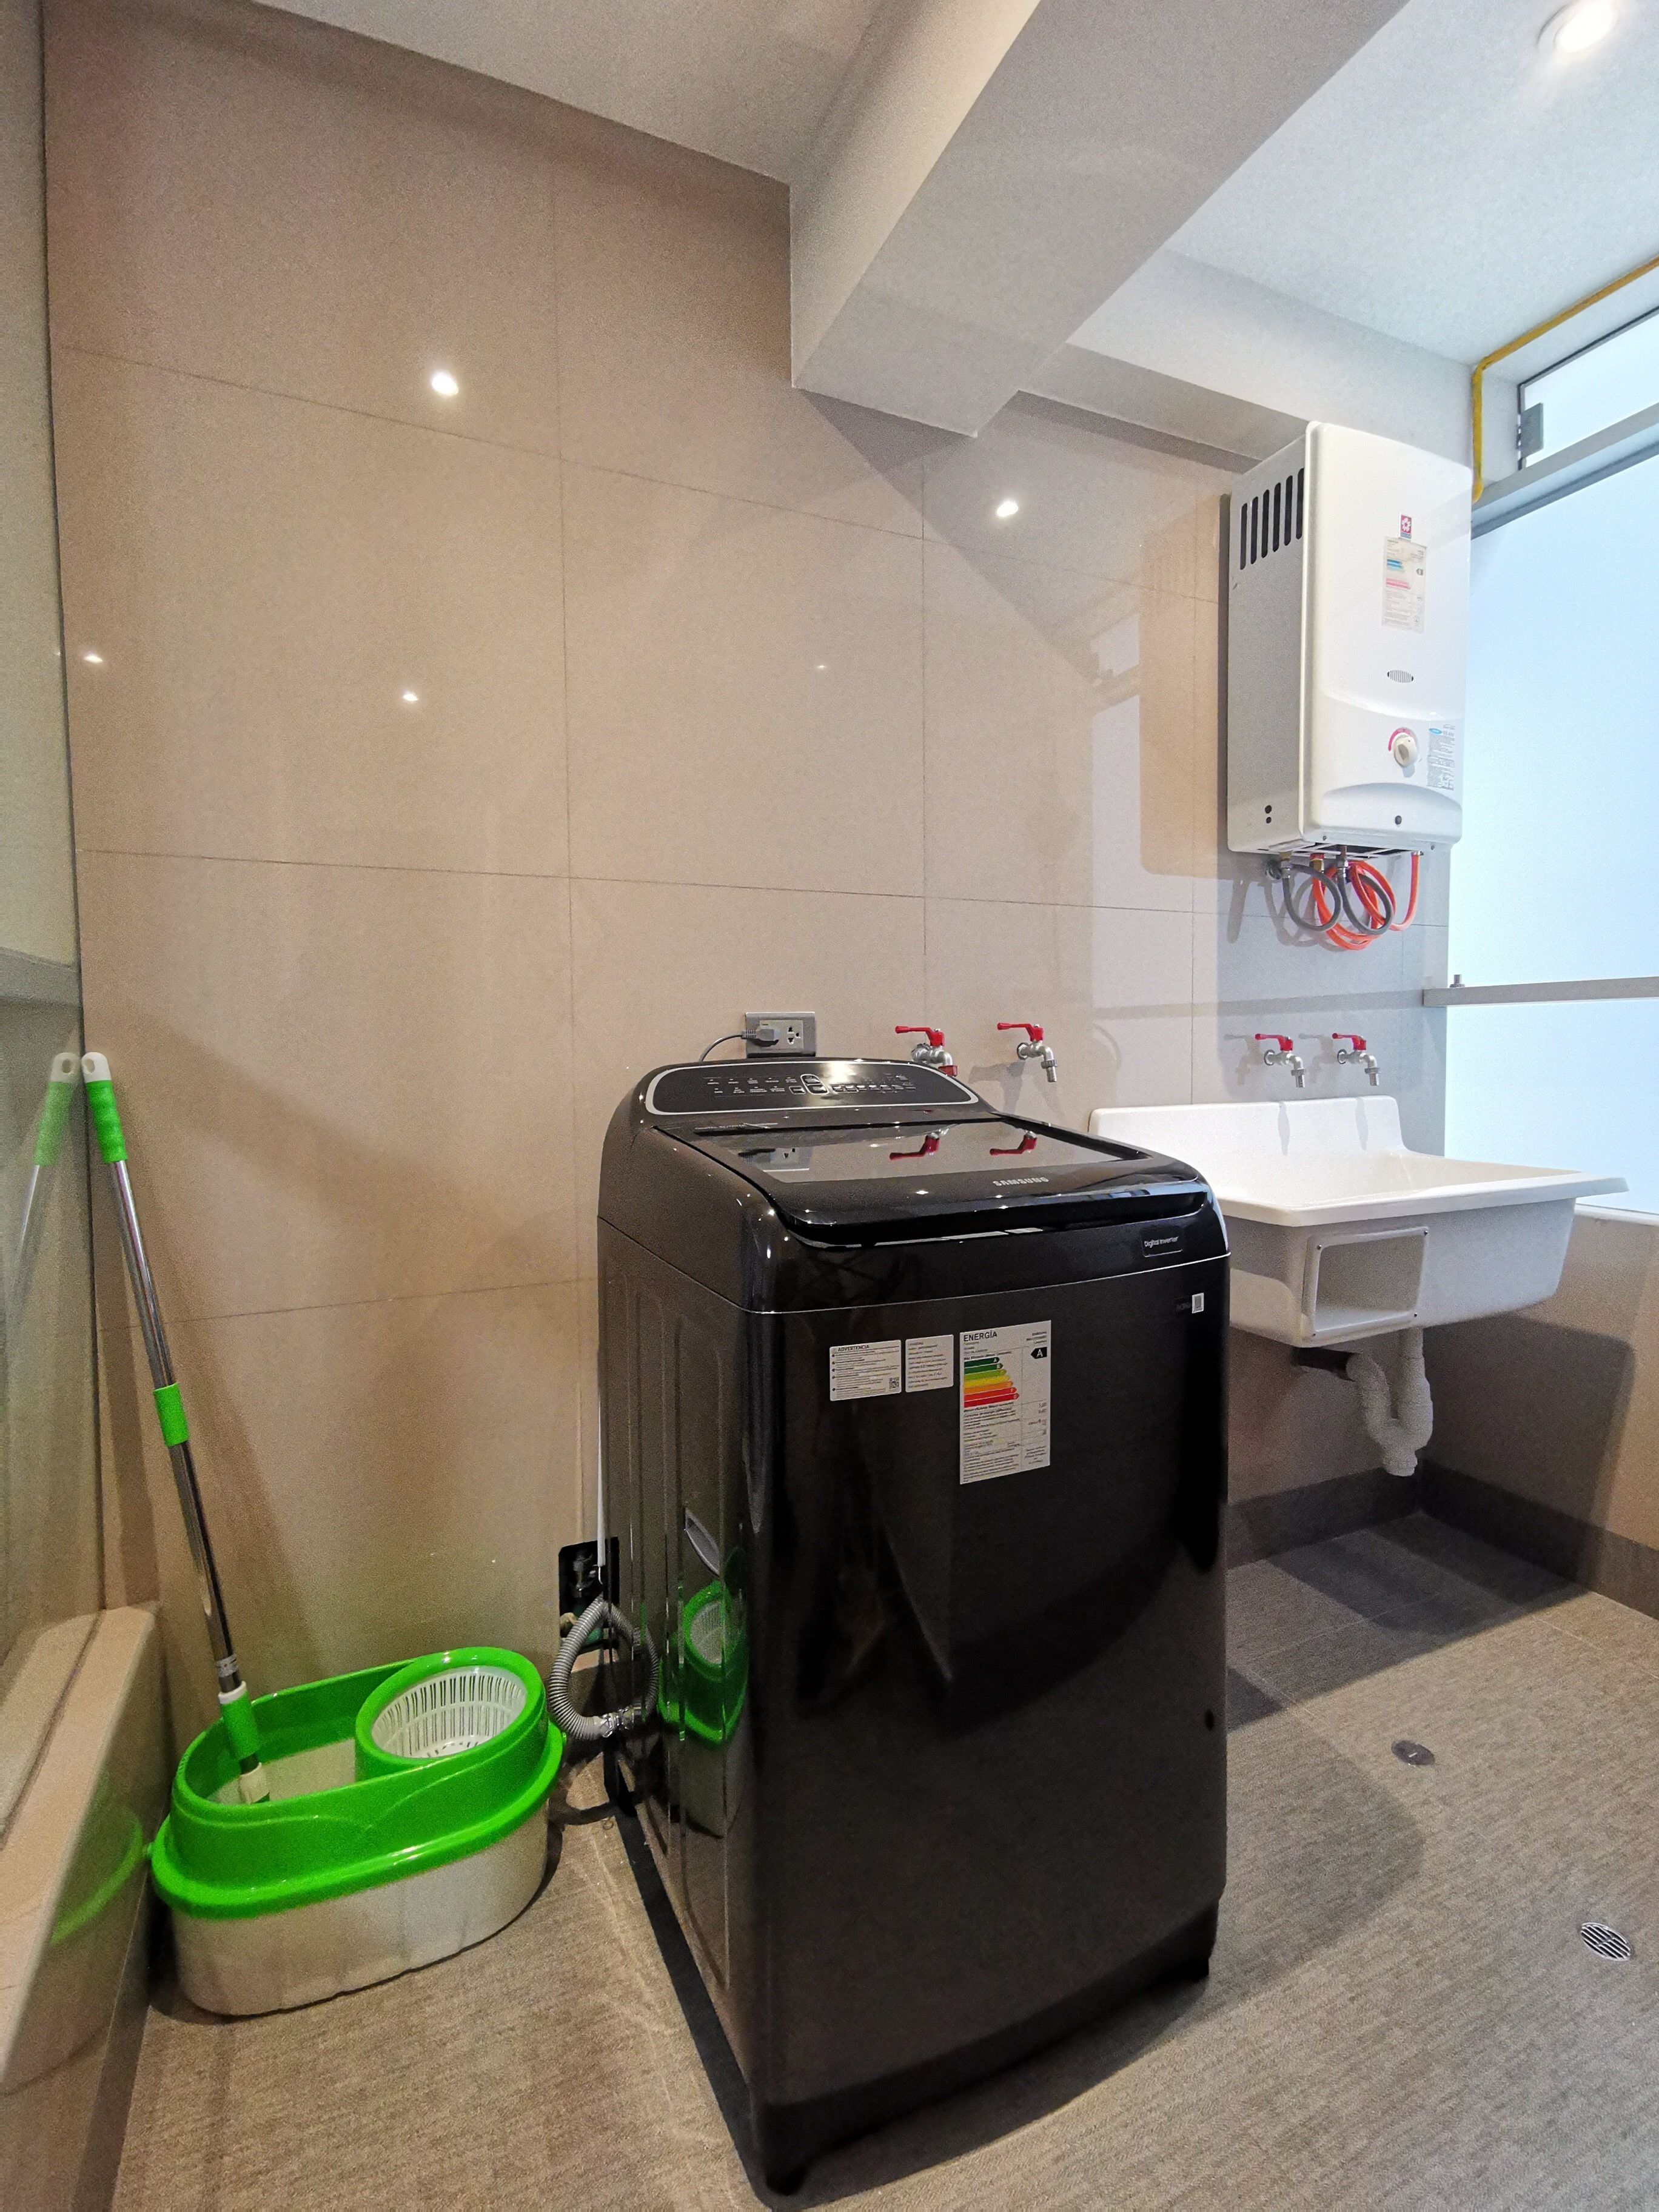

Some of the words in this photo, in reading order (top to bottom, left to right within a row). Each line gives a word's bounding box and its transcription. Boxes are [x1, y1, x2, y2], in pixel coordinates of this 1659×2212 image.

[993, 1176, 1049, 1187] SAMSUNG
[1144, 1239, 1159, 1248] Digital
[964, 1330, 997, 1342] ENERGÍA
[1036, 1349, 1043, 1358] A
